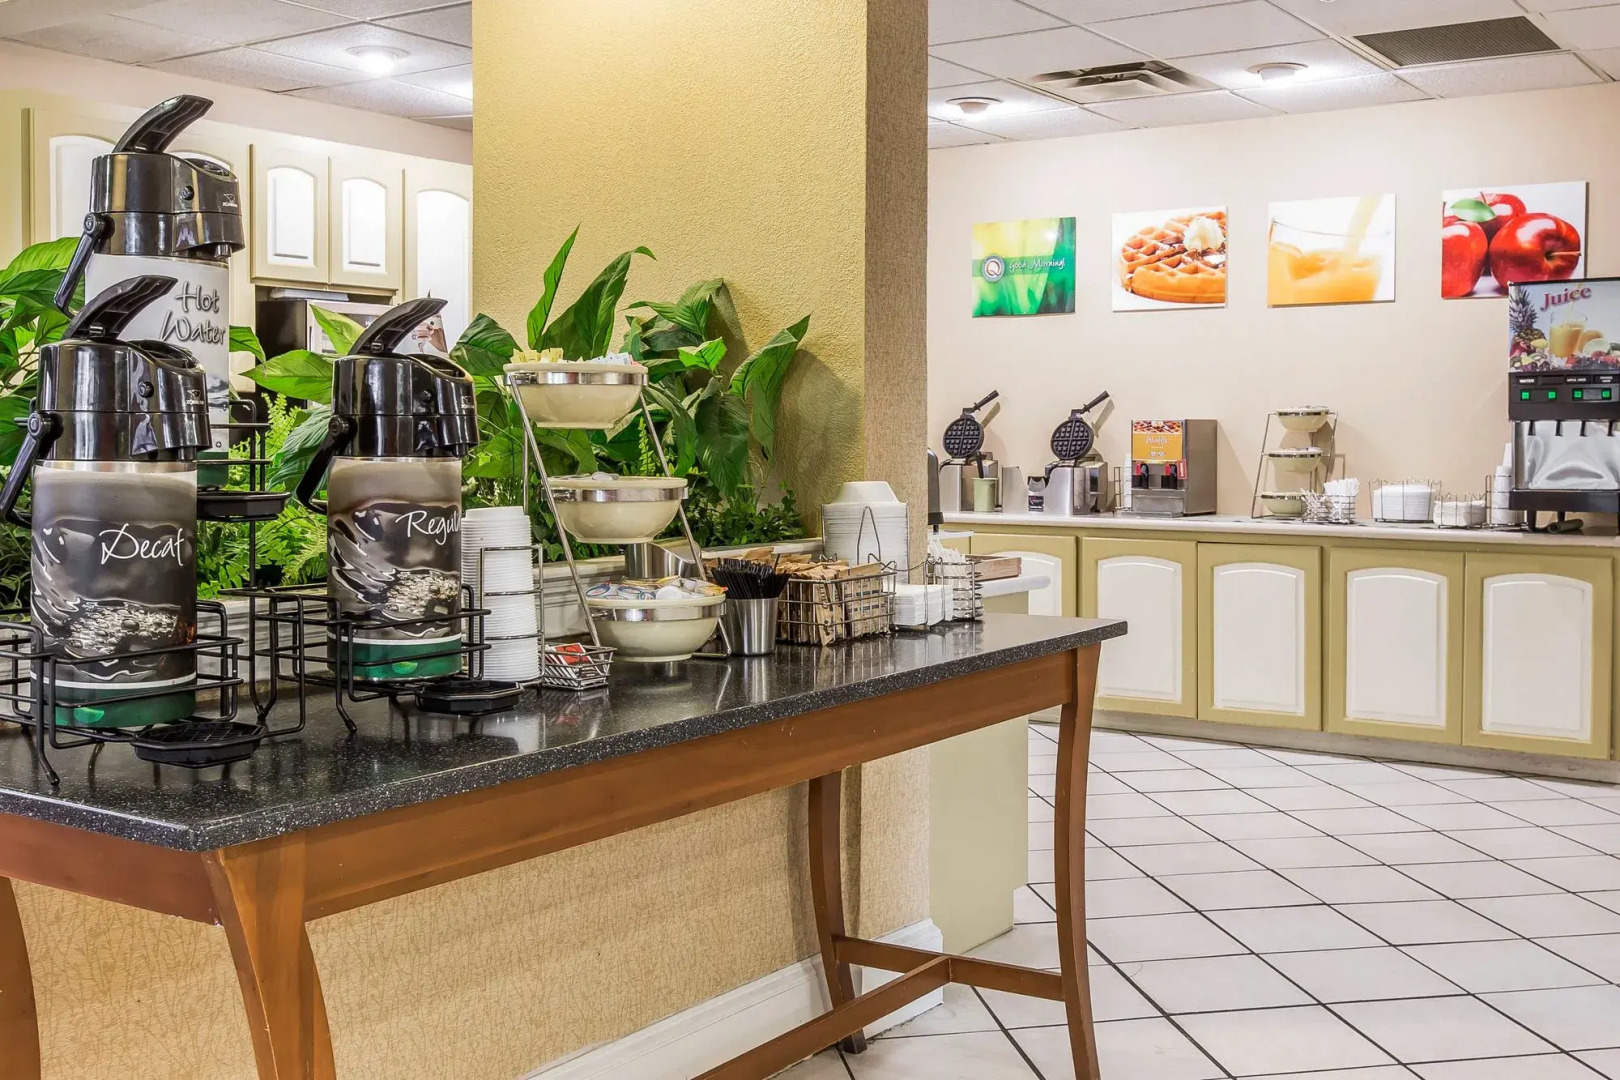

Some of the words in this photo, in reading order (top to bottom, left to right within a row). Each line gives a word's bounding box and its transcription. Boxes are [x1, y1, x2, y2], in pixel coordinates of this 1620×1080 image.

[1009, 260, 1026, 274] Good
[1030, 257, 1065, 271] Morning!
[174, 281, 219, 312] Hot
[1540, 286, 1592, 311] Juice
[160, 310, 226, 345] Water
[99, 522, 184, 566] Decaf
[395, 510, 460, 545] Regul
